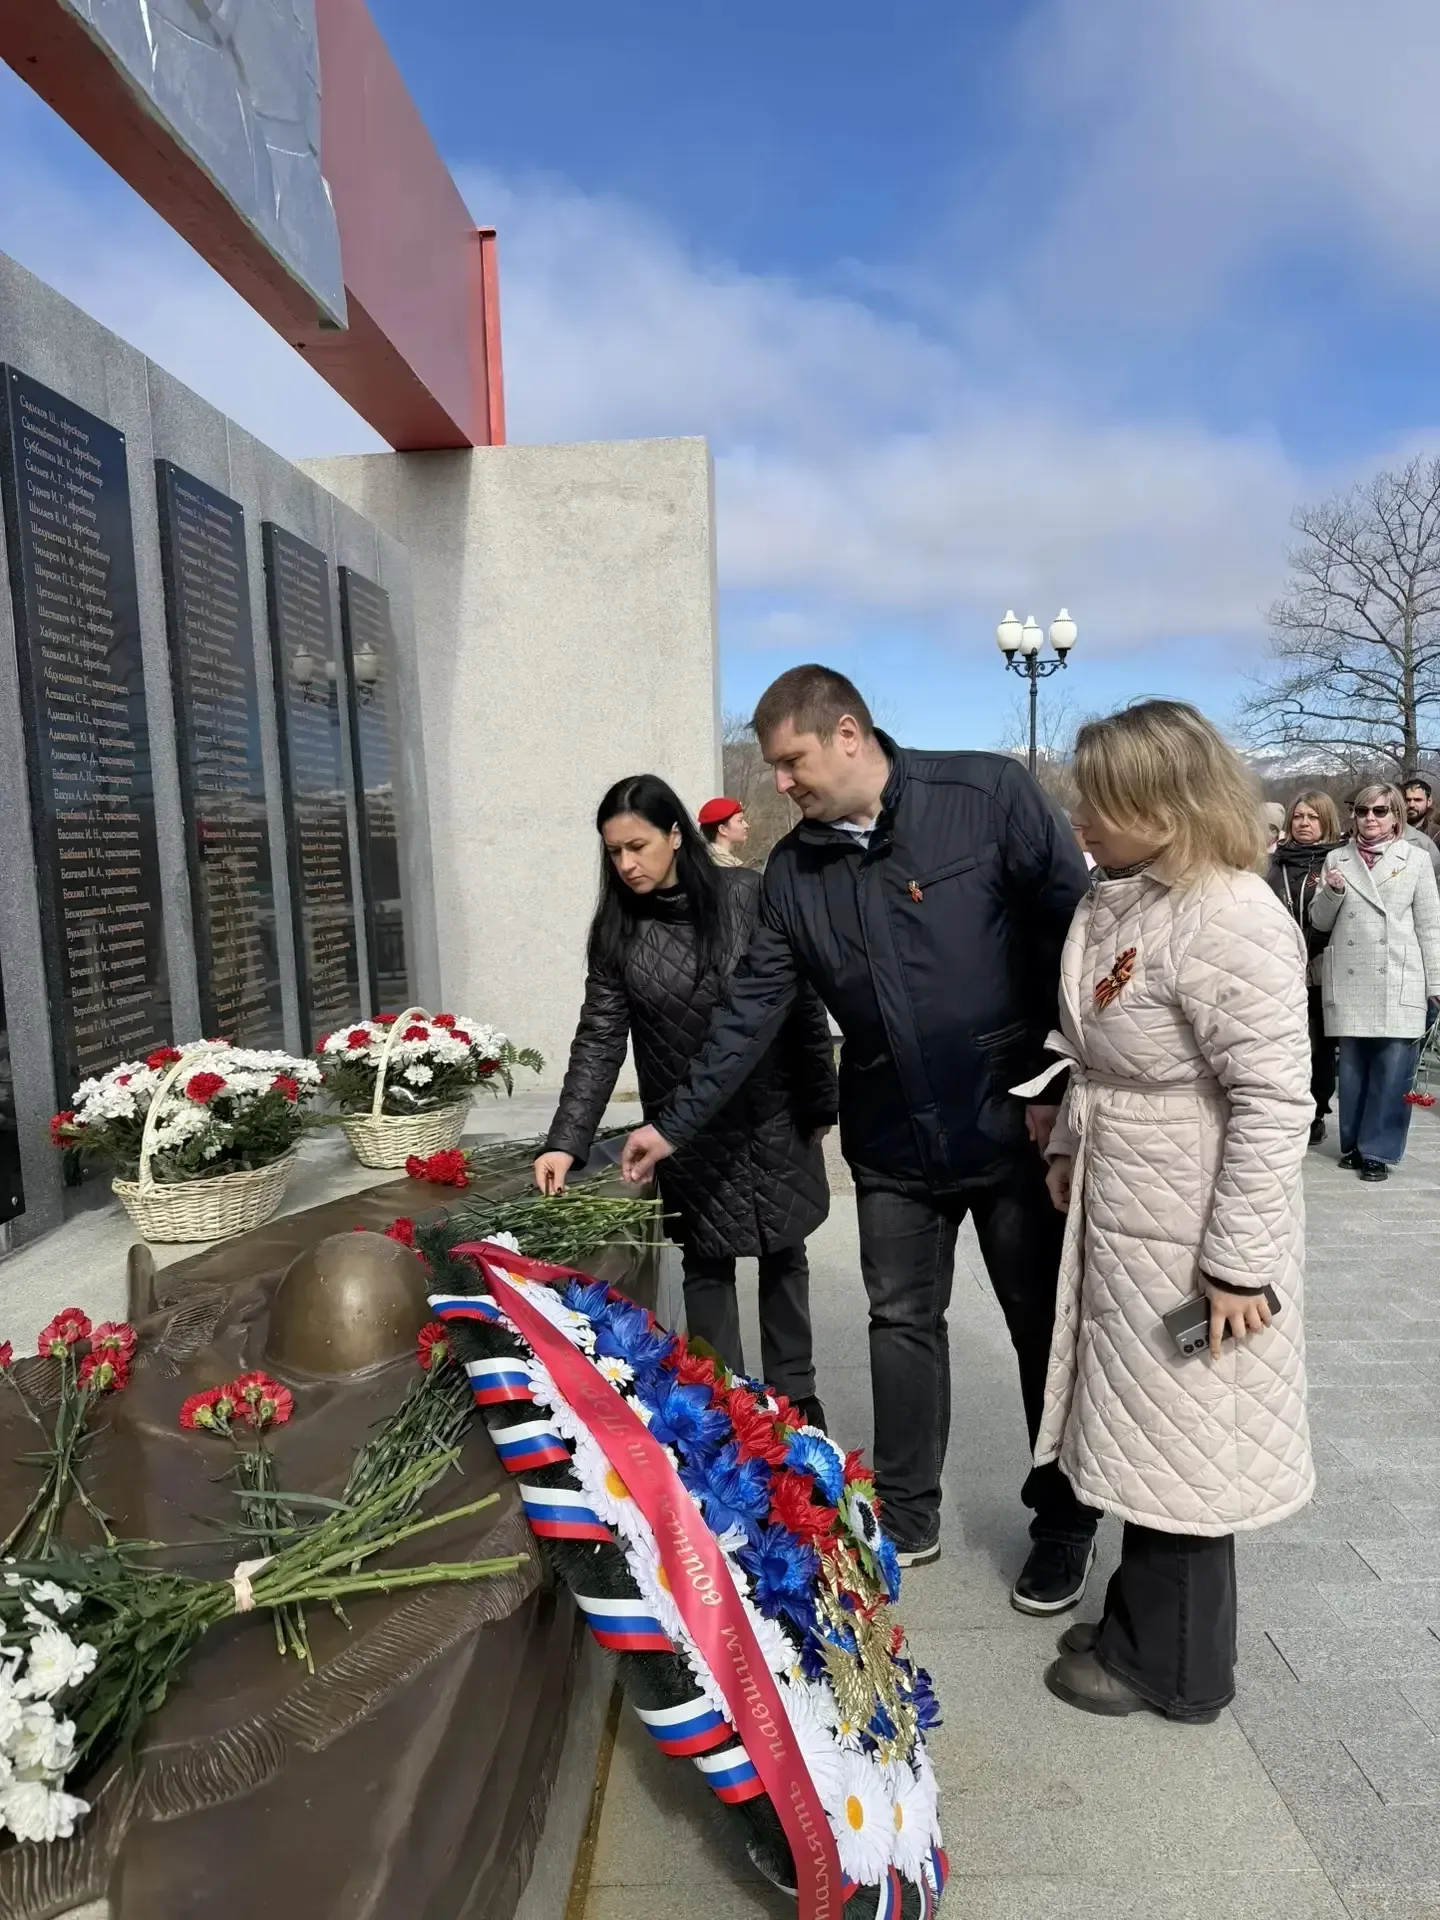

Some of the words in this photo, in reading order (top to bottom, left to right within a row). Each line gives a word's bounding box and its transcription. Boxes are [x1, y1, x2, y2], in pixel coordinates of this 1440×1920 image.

[24, 437, 56, 463] Субботин
[654, 1493, 723, 1606] воинам
[719, 1623, 785, 1762] павшим
[788, 1780, 830, 1920] память
